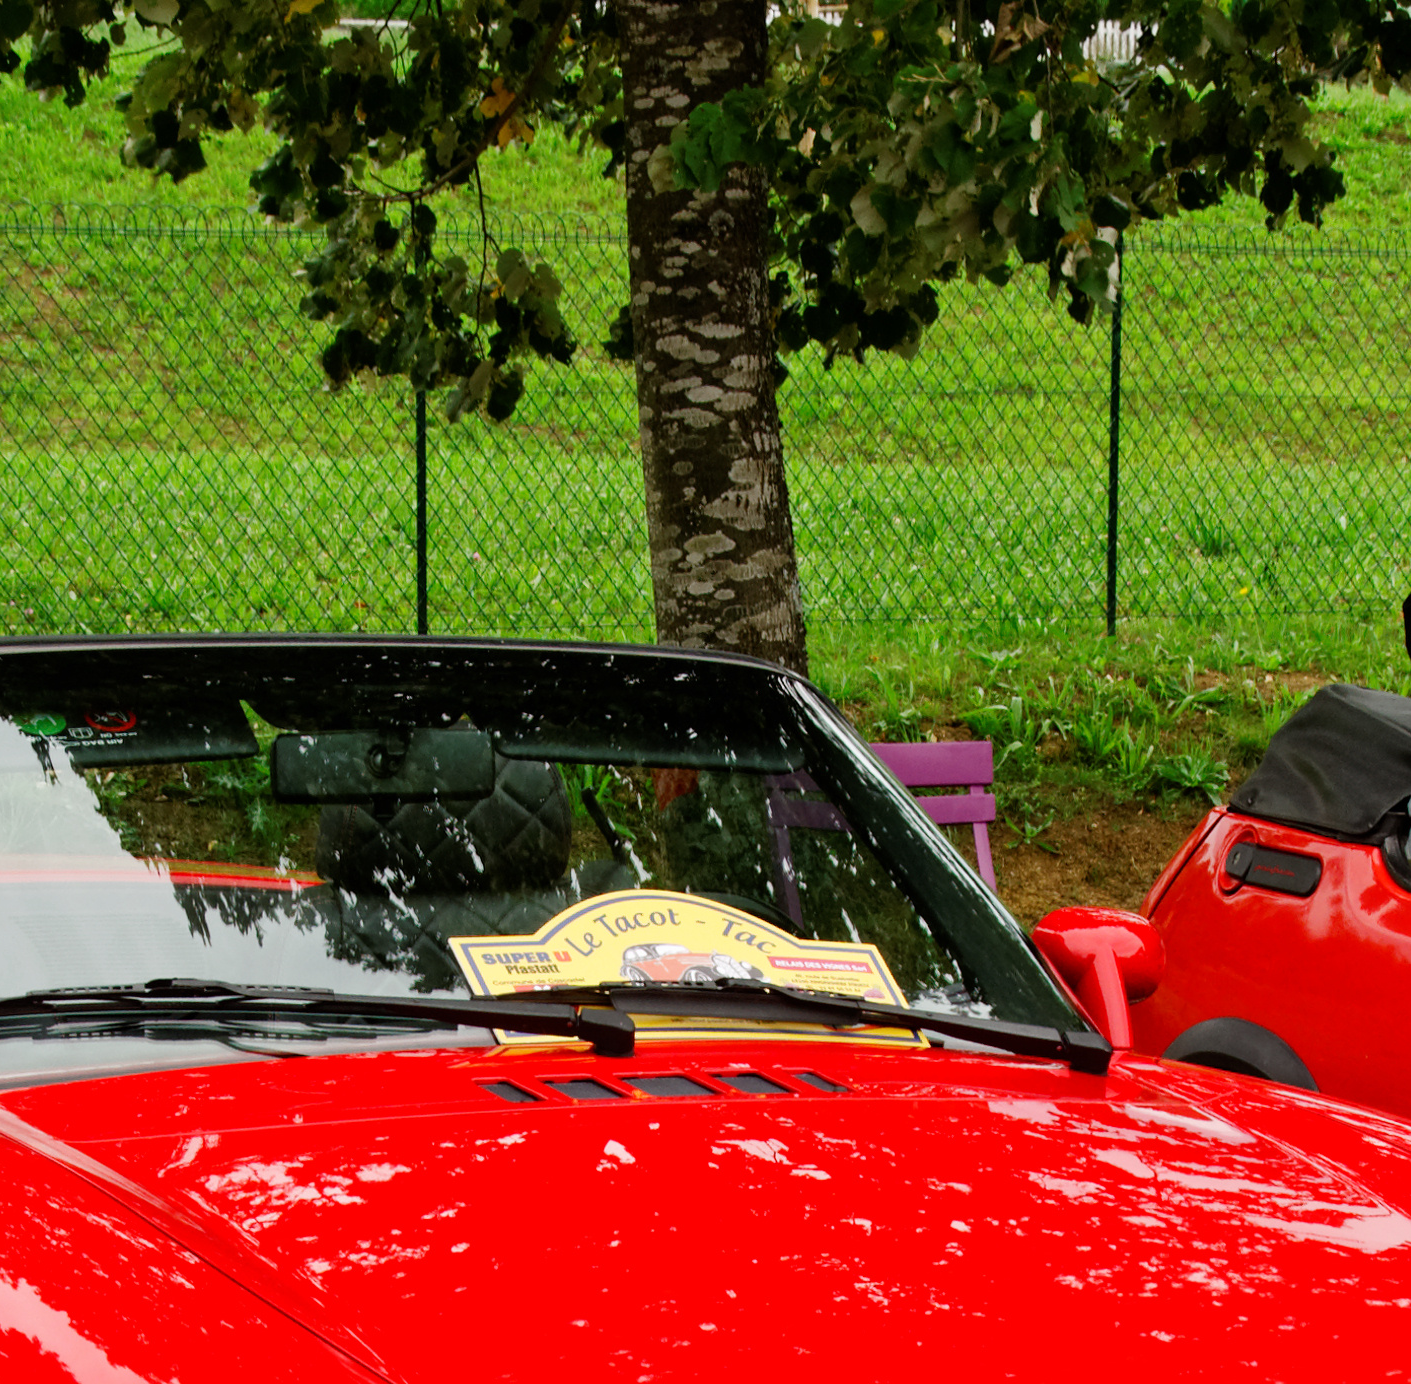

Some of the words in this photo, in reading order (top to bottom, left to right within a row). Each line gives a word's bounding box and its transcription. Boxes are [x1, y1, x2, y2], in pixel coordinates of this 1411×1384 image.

[564, 931, 602, 957] Le
[593, 907, 682, 938] Tacot
[721, 917, 776, 955] Tac
[481, 951, 551, 966] SUPER
[553, 950, 572, 963] U
[775, 958, 804, 969] RELAIS
[804, 960, 822, 970] DES
